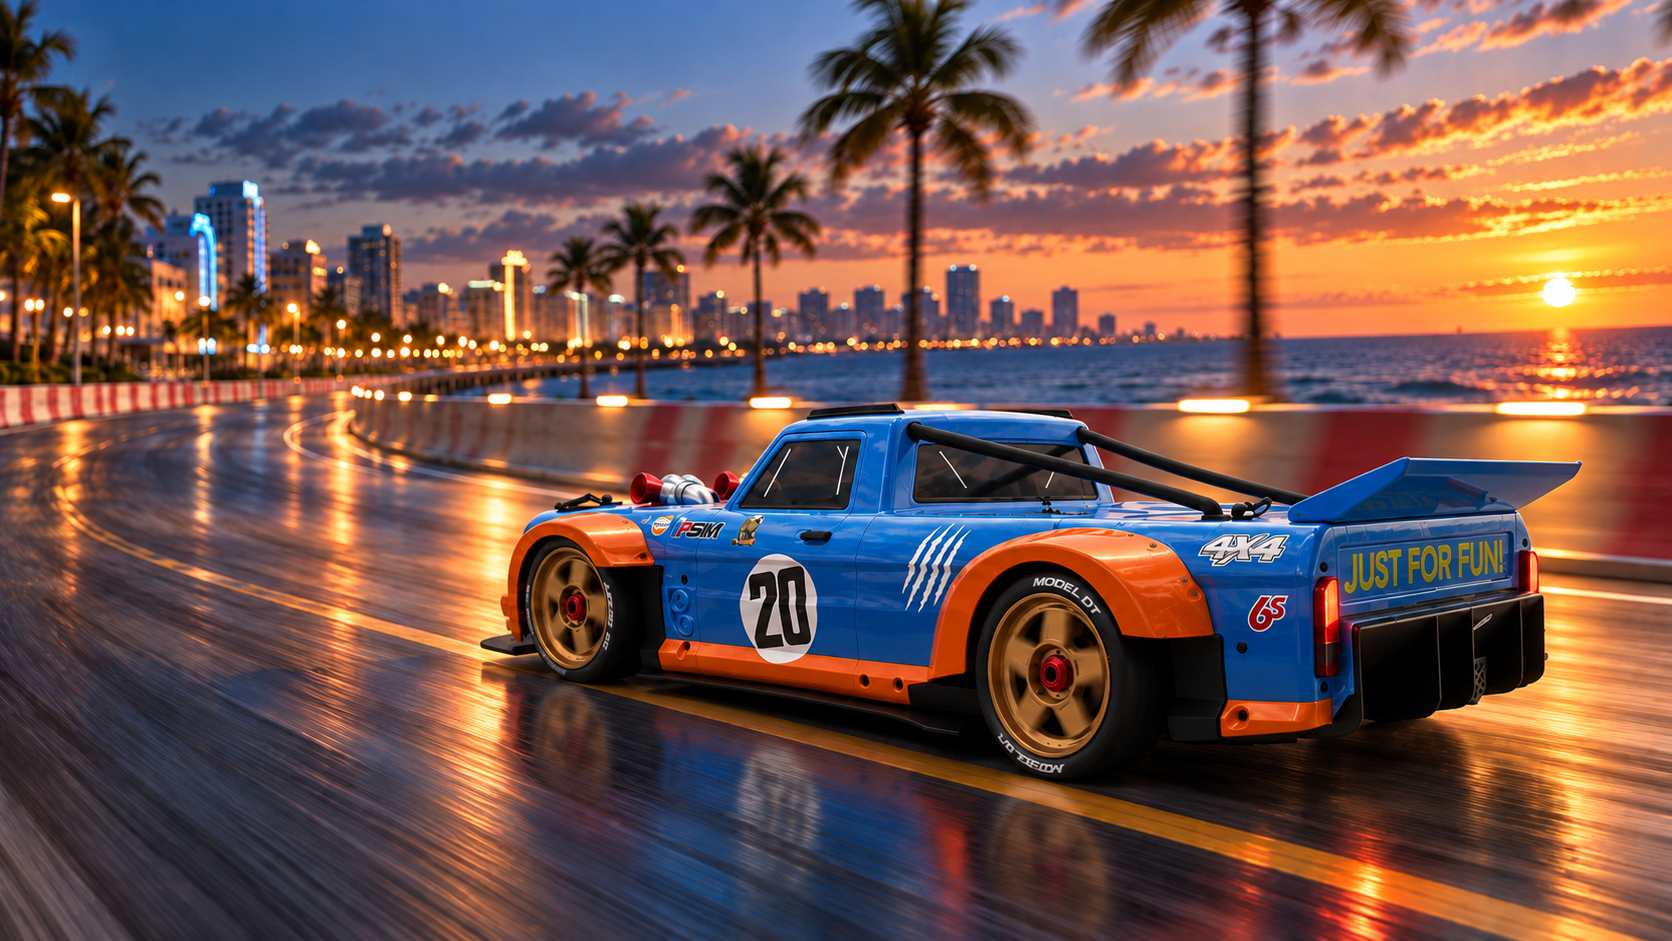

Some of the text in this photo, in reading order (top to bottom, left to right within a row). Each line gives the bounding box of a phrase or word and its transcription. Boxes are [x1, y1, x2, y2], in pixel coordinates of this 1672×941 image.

[1344, 539, 1504, 594] JUST FOR FUN!
[748, 565, 812, 649] 20
[1032, 576, 1102, 614] MODEL DT
